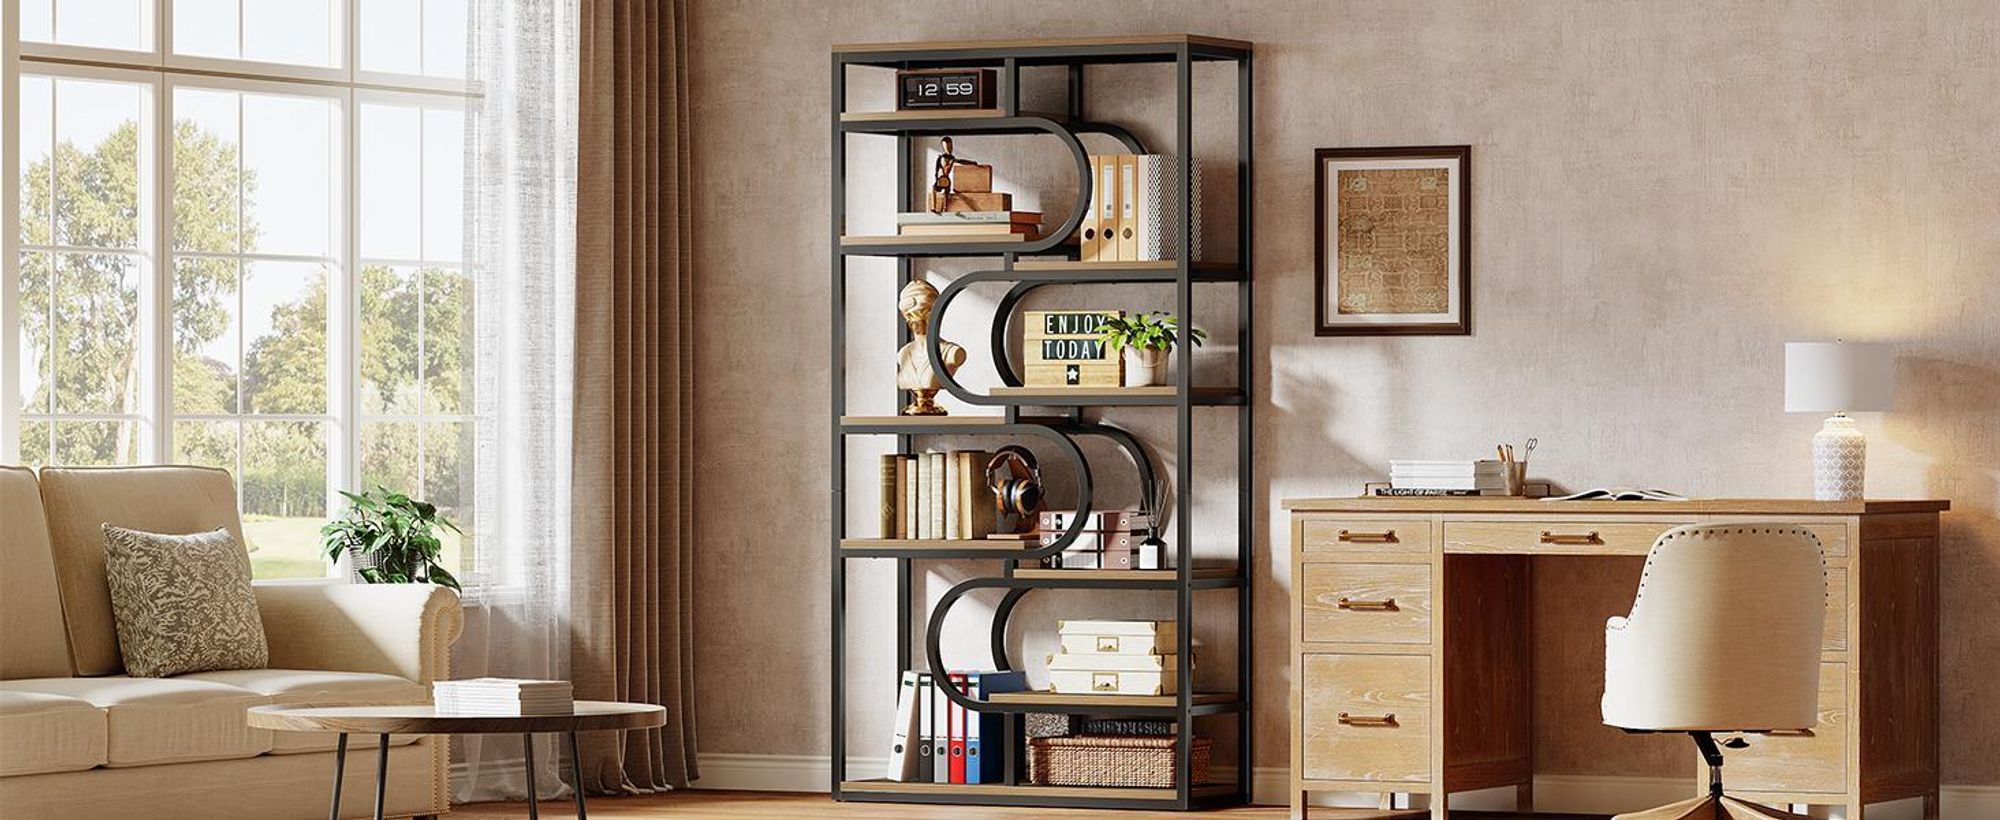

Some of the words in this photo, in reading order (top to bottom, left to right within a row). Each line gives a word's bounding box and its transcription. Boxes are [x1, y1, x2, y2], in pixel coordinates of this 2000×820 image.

[918, 83, 938, 96] 12
[946, 83, 973, 96] 59
[1046, 314, 1105, 334] ENJOY
[1044, 340, 1103, 359] TODAY
